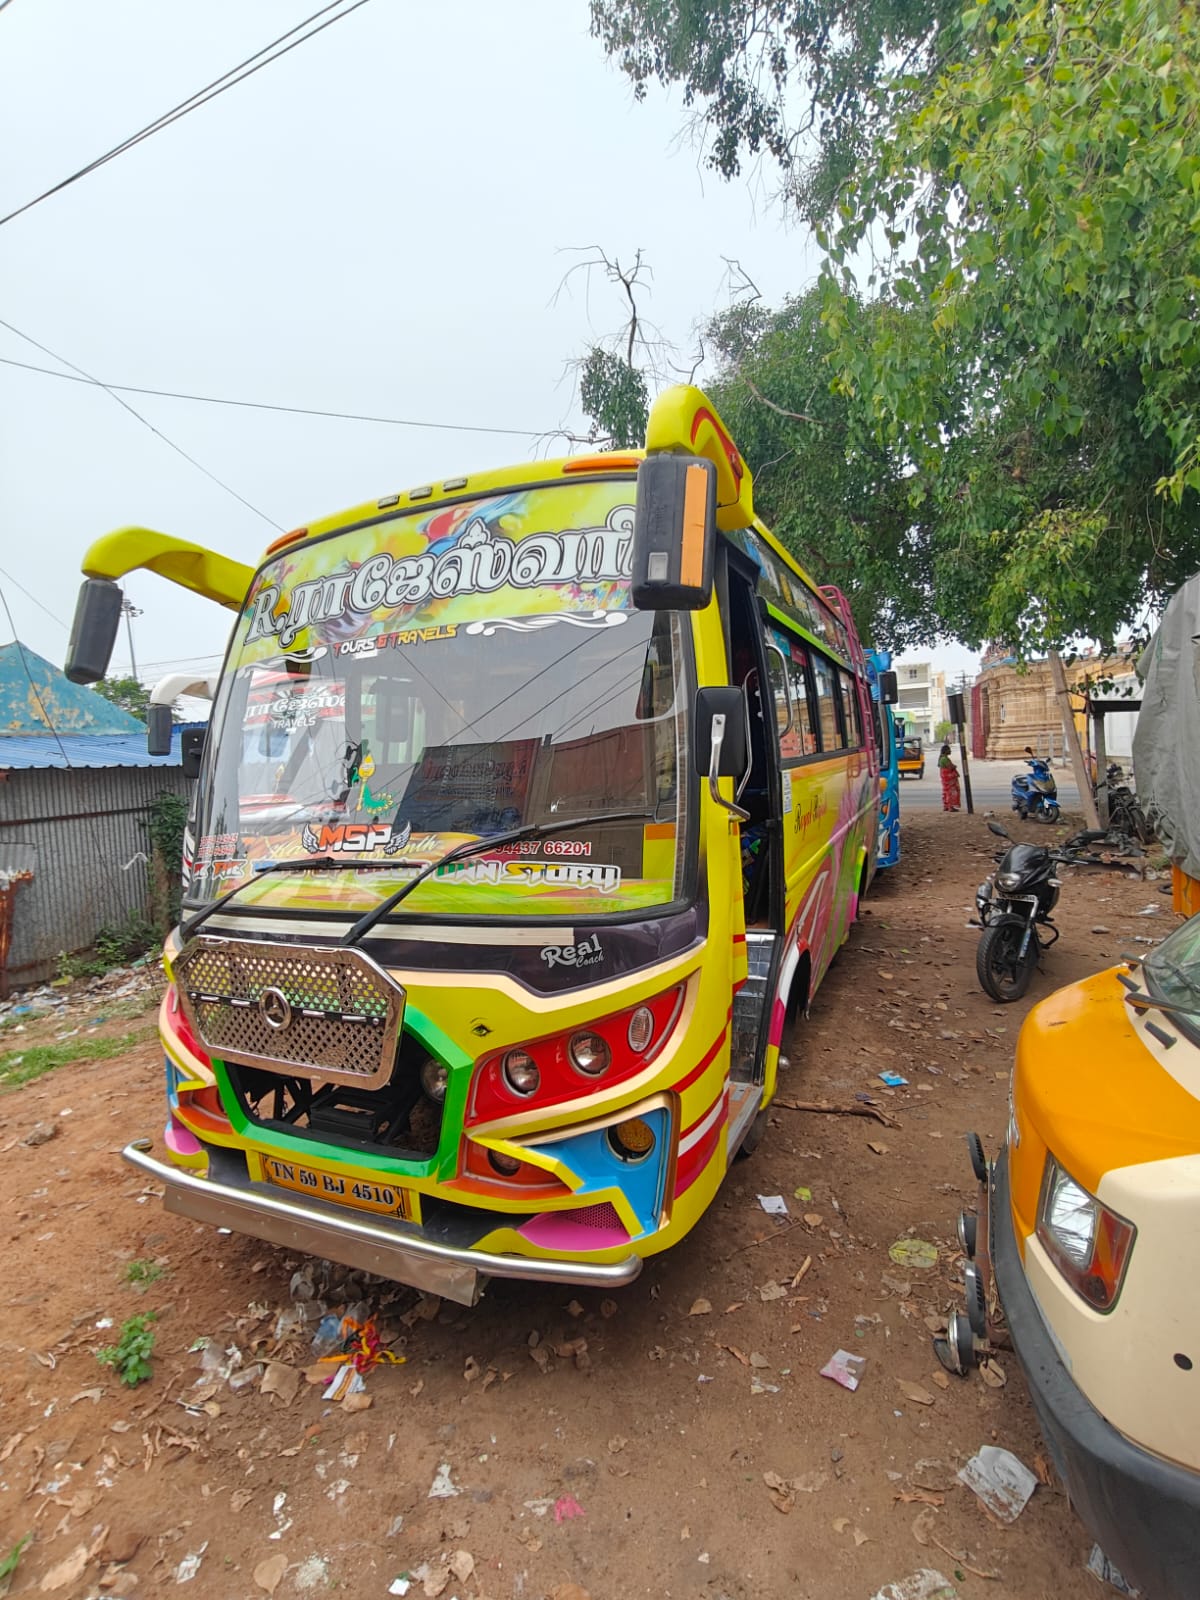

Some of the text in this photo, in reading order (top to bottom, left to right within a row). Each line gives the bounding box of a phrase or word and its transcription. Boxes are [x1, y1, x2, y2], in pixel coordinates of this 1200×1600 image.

[333, 636, 378, 658] TOURS
[389, 623, 459, 649] TRAVELS
[272, 716, 316, 729] TRAVELS
[318, 823, 392, 853] MSP
[543, 840, 592, 856] 66201
[502, 861, 621, 892] STORY
[540, 933, 605, 968] Real Coach
[271, 1160, 395, 1205] TN 59 BJ 4510
